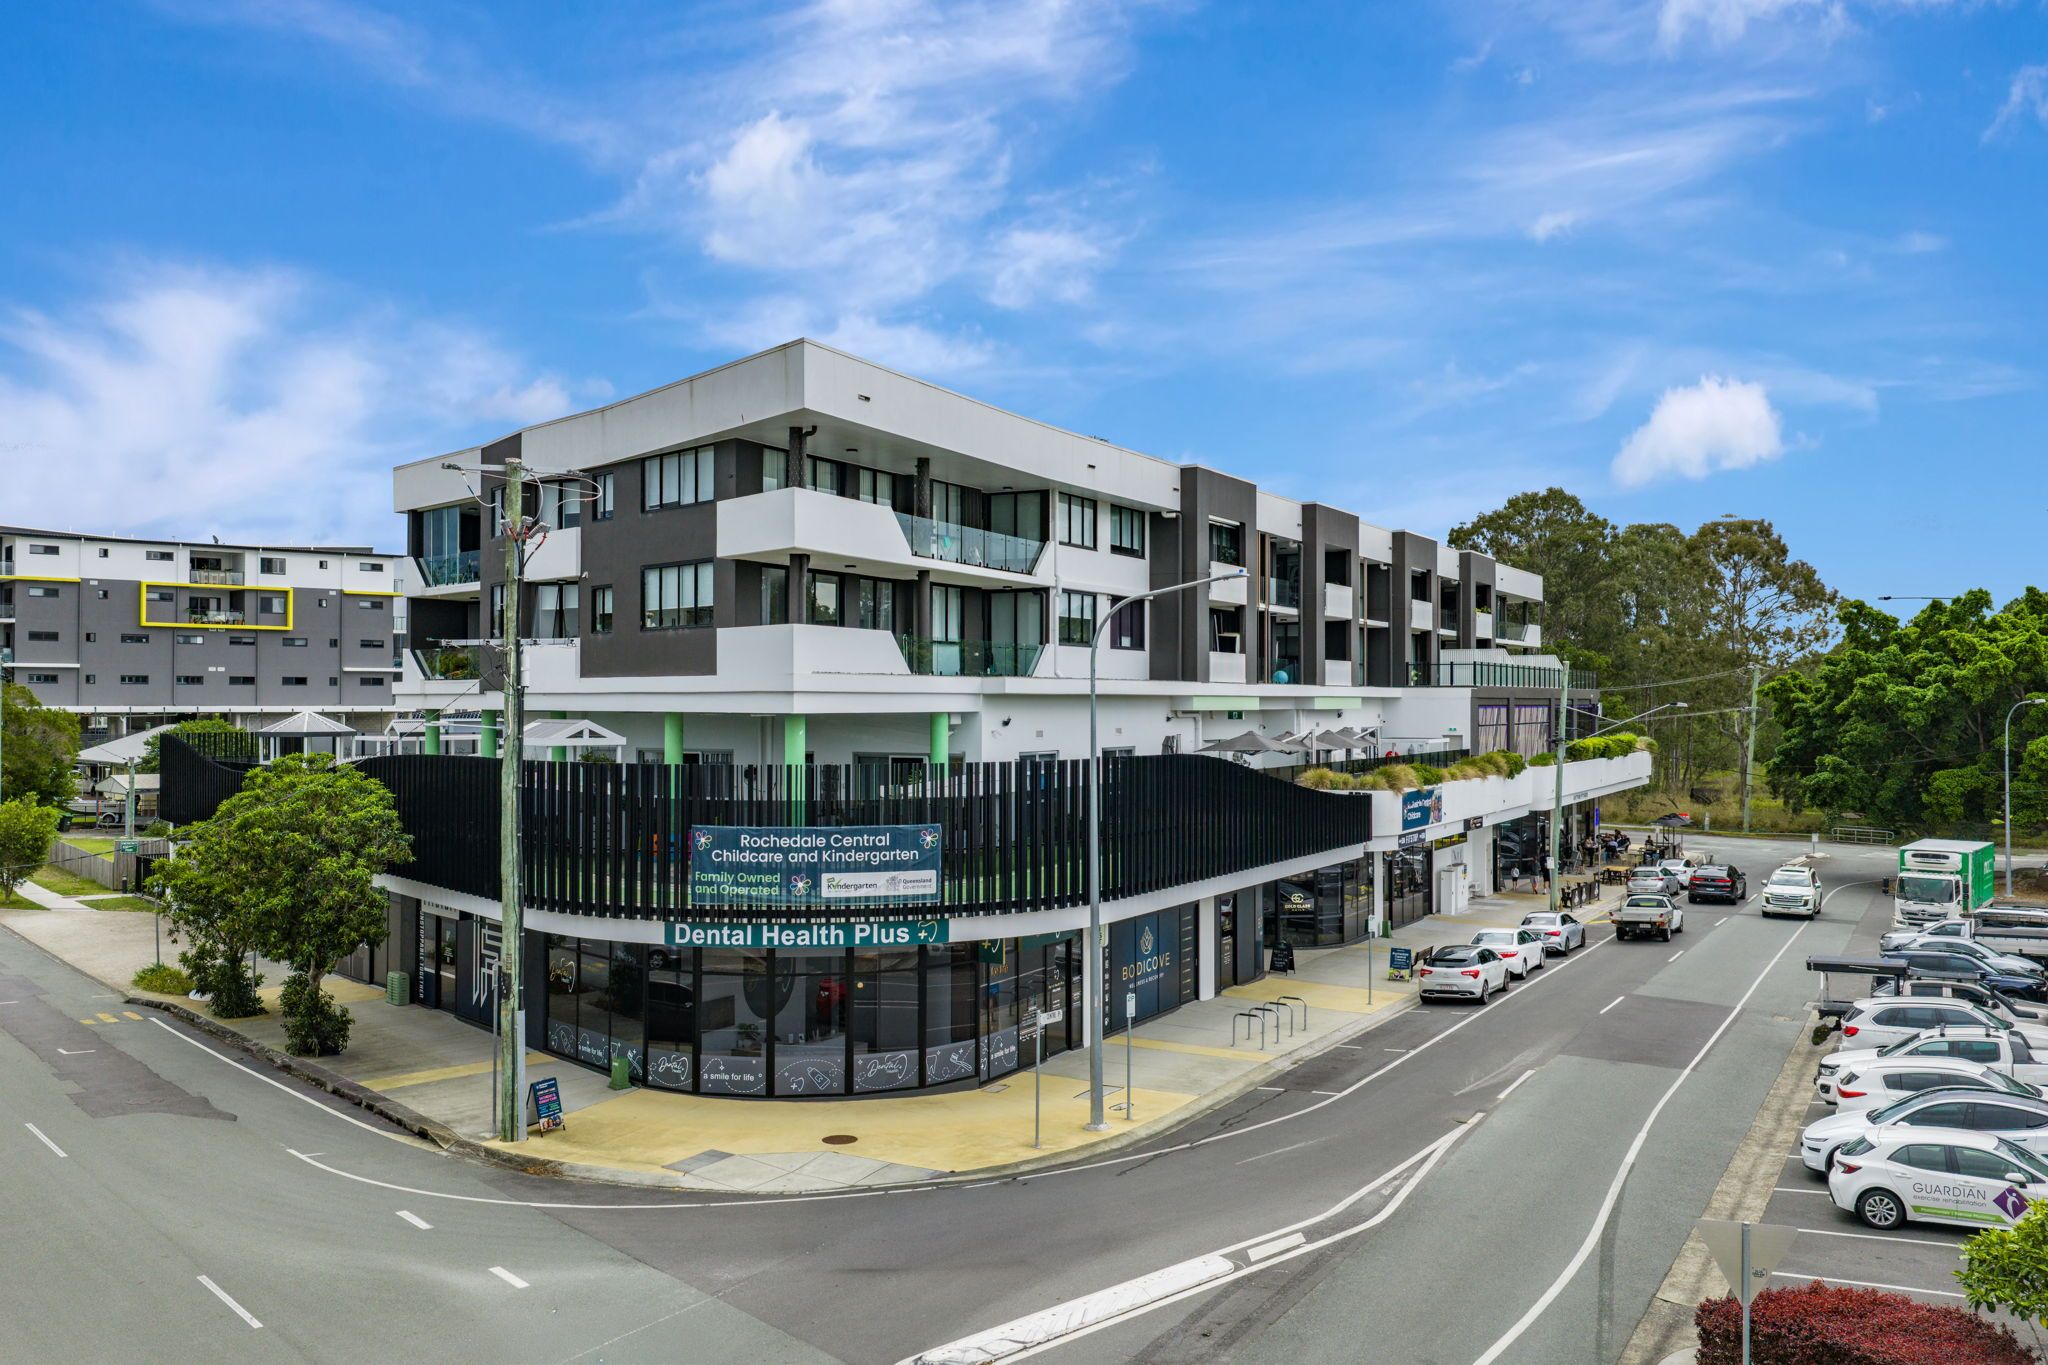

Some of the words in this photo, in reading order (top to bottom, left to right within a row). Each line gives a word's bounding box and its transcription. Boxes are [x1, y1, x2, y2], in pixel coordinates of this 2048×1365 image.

[741, 834, 826, 848] Rochedale
[830, 833, 890, 847] Central
[711, 849, 784, 863] Childcare
[788, 850, 818, 863] and
[822, 849, 919, 865] Kindergarten
[695, 872, 735, 885] Family
[737, 872, 781, 883] Owned
[902, 877, 932, 885] Queensland
[695, 884, 717, 894] and
[720, 884, 780, 897] Operated
[675, 923, 751, 945] Dental
[762, 924, 844, 946] Health
[855, 923, 910, 944] Plus
[1122, 952, 1170, 980] BODICOVE
[658, 1056, 683, 1073] Dental
[867, 1059, 900, 1078] Dental
[710, 1073, 729, 1081] smile
[731, 1073, 741, 1081] for
[743, 1074, 755, 1082] life
[1912, 1182, 1986, 1200] GUARDIAN
[1912, 1194, 1940, 1202] exercise
[1942, 1198, 1987, 1208] rehabilitation
